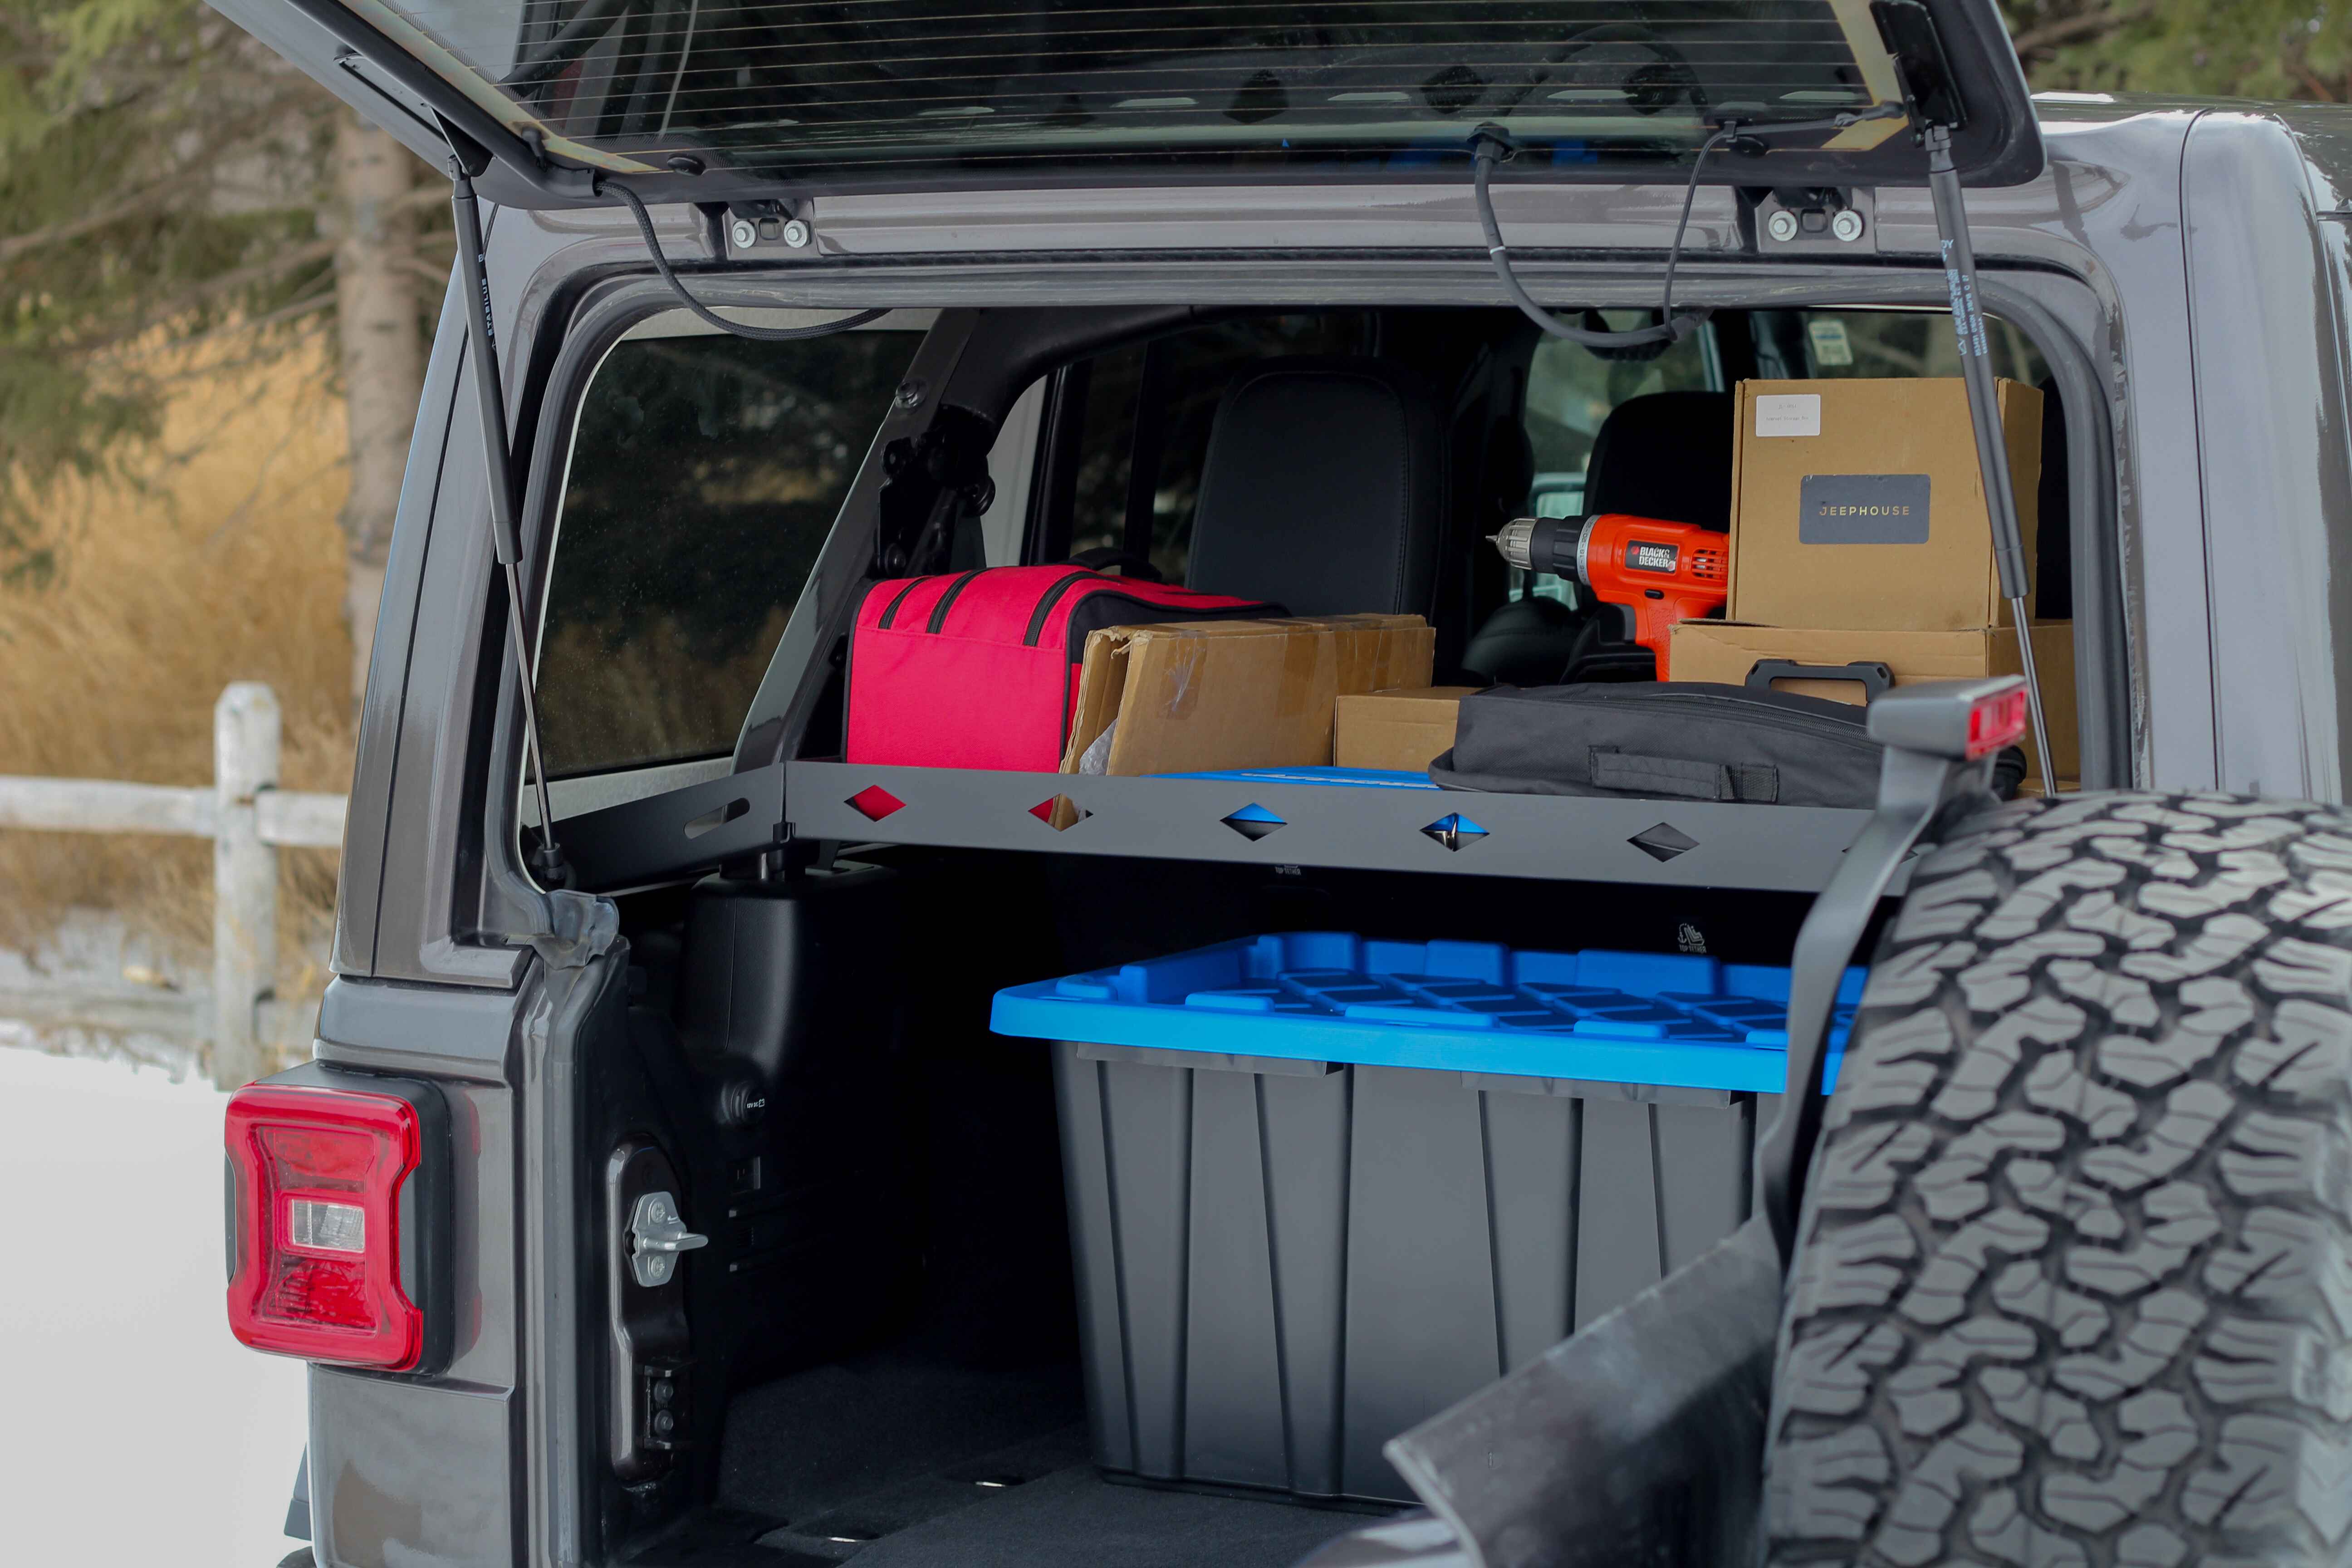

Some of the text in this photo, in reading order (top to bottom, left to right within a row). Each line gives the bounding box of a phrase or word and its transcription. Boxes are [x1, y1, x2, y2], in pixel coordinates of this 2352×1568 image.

[482, 278, 494, 336] STABILUS
[1819, 506, 1910, 516] JEEPHOUSE
[1582, 533, 1588, 543] 20
[1639, 556, 1668, 568] DECKER
[1688, 945, 1706, 953] TETHER
